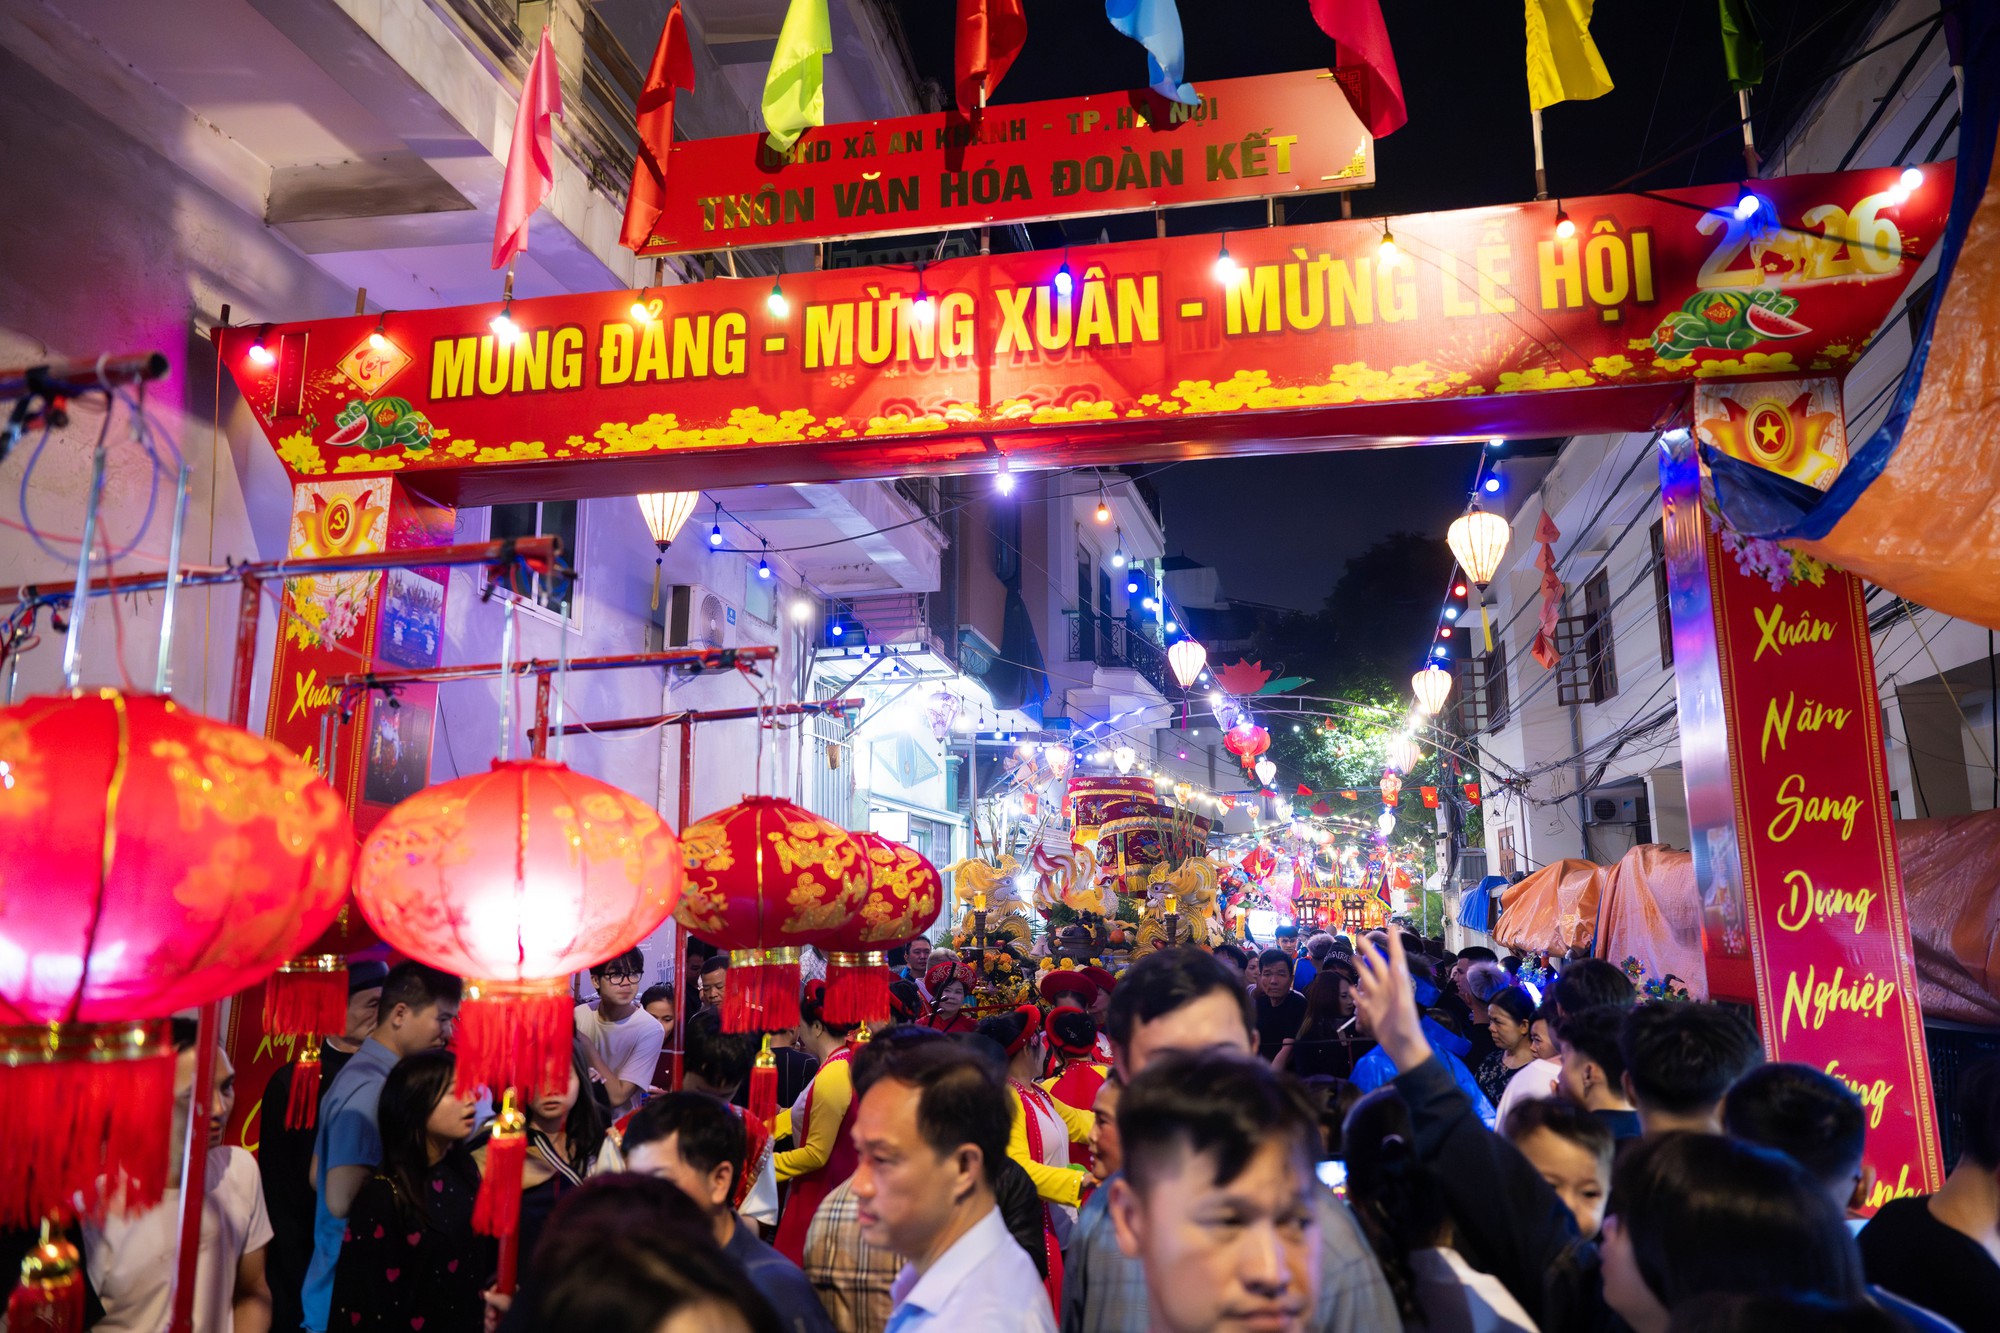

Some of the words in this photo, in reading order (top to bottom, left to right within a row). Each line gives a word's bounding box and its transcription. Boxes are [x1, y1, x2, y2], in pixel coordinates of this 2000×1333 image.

[697, 183, 816, 232] THÔN
[833, 171, 920, 218] VĂN
[940, 160, 1033, 208] HÓA
[1051, 146, 1184, 197] ĐOÀN
[1205, 127, 1298, 182] KẾT
[843, 131, 877, 159] XÃ
[888, 130, 923, 155] AN
[600, 298, 746, 385] ĐẢNG
[805, 286, 975, 369] MỪNG
[994, 267, 1159, 354] XUÂN
[1225, 248, 1418, 335] MỪNG
[1442, 218, 1517, 318] LỄ
[1537, 220, 1655, 321] HỘI
[1753, 603, 1838, 662] Xuân
[1761, 691, 1852, 764] Năm
[1767, 774, 1864, 842] Sang
[1777, 870, 1877, 934] Dựng
[1782, 964, 1895, 1043] Nghiệp
